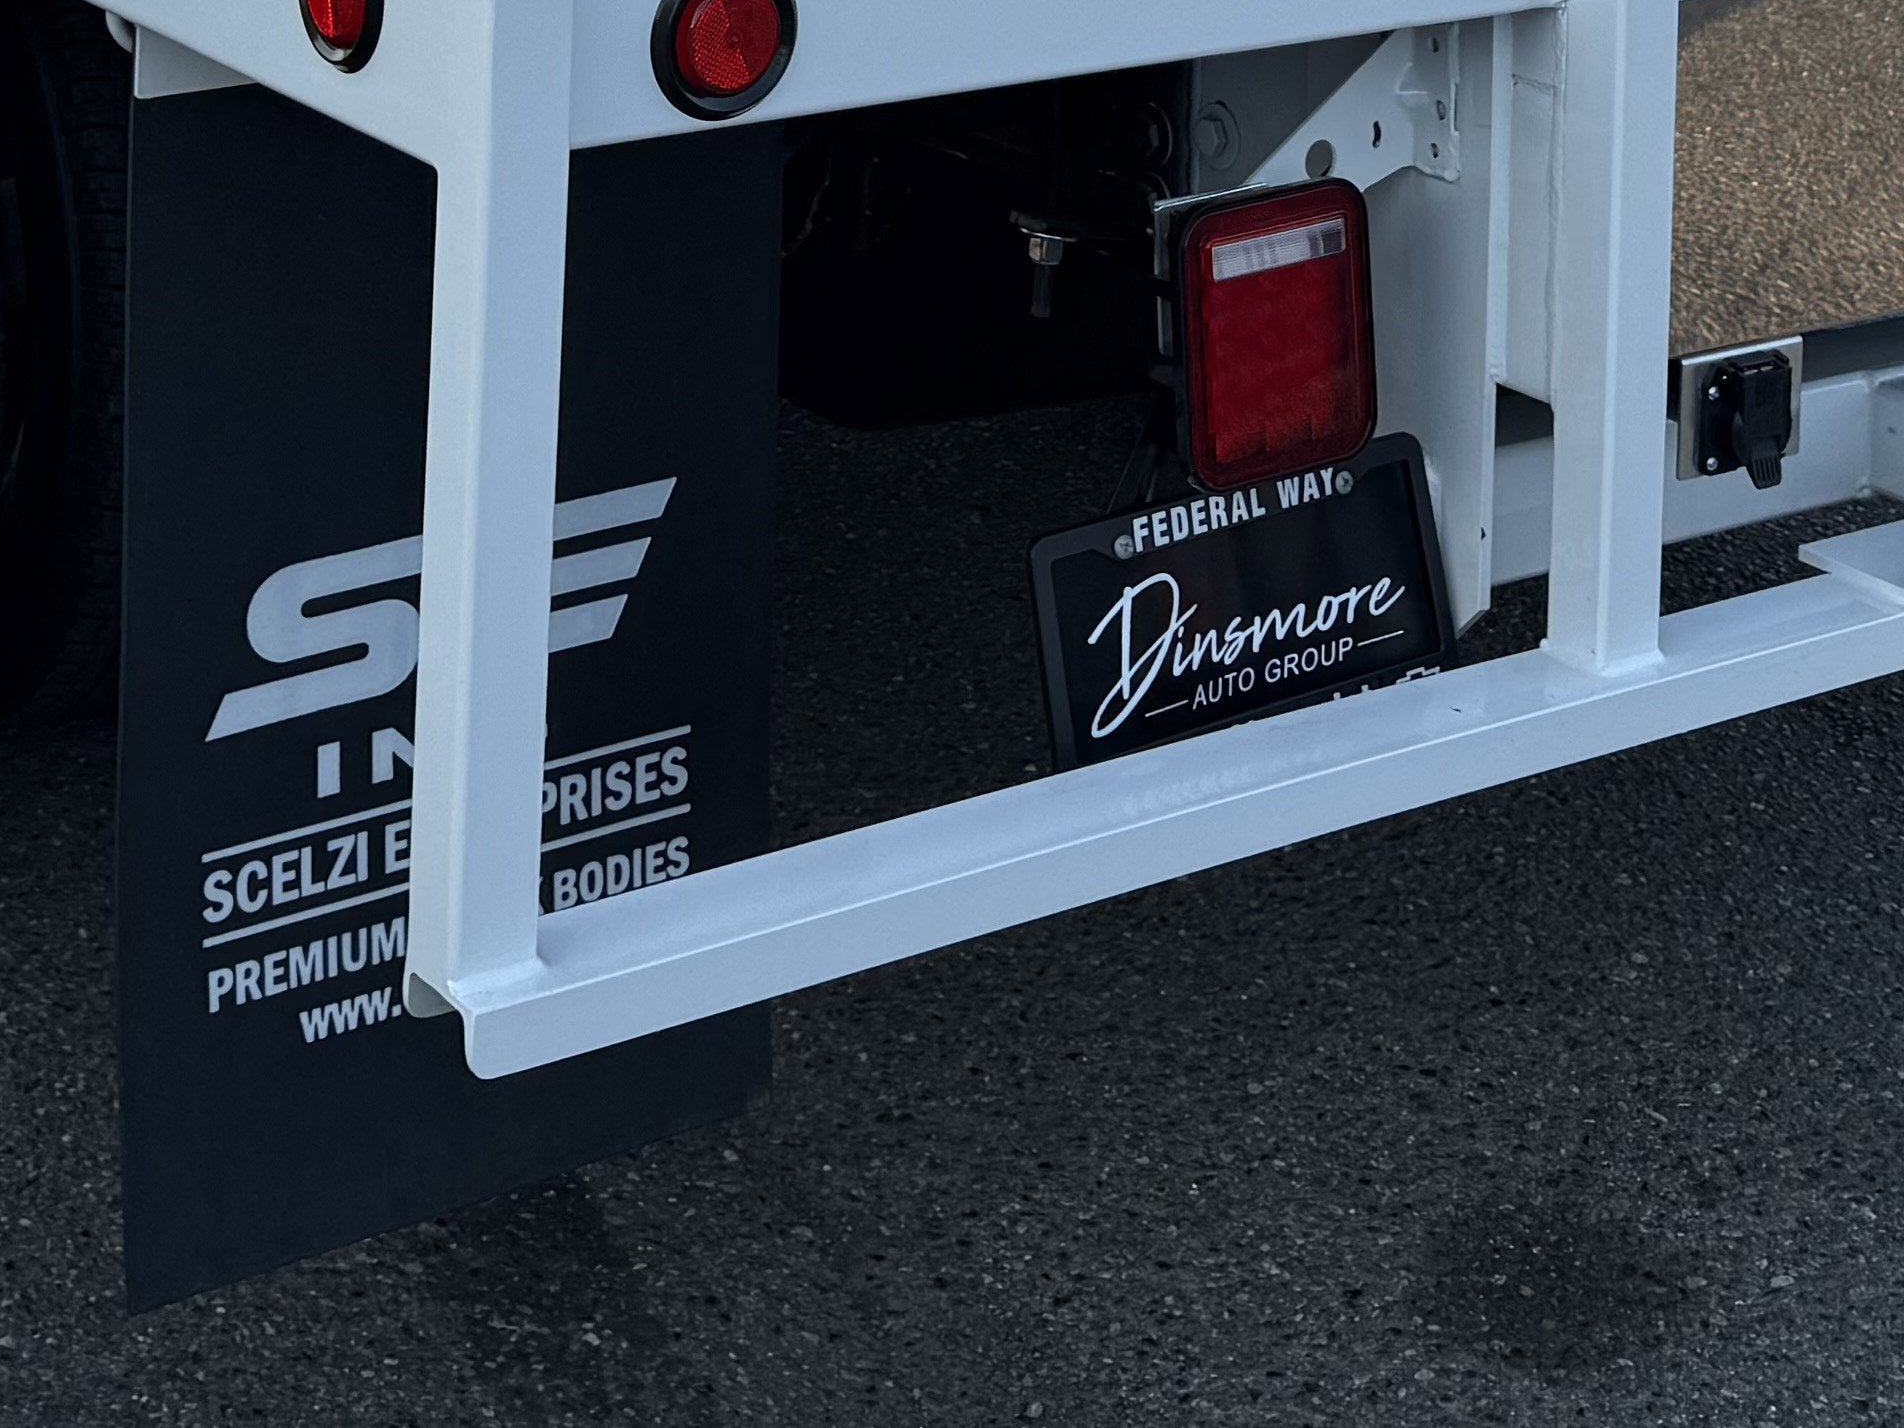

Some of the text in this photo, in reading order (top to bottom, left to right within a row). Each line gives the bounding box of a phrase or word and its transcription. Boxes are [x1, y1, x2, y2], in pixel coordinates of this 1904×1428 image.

[1132, 467, 1336, 553] FEDERAL WAY
[1088, 572, 1406, 738] Dinsmore
[1192, 636, 1354, 710] AUTO GROUP
[202, 831, 369, 924] SCELZI
[208, 916, 405, 1014] PREMIUM
[553, 836, 690, 912] BODIES
